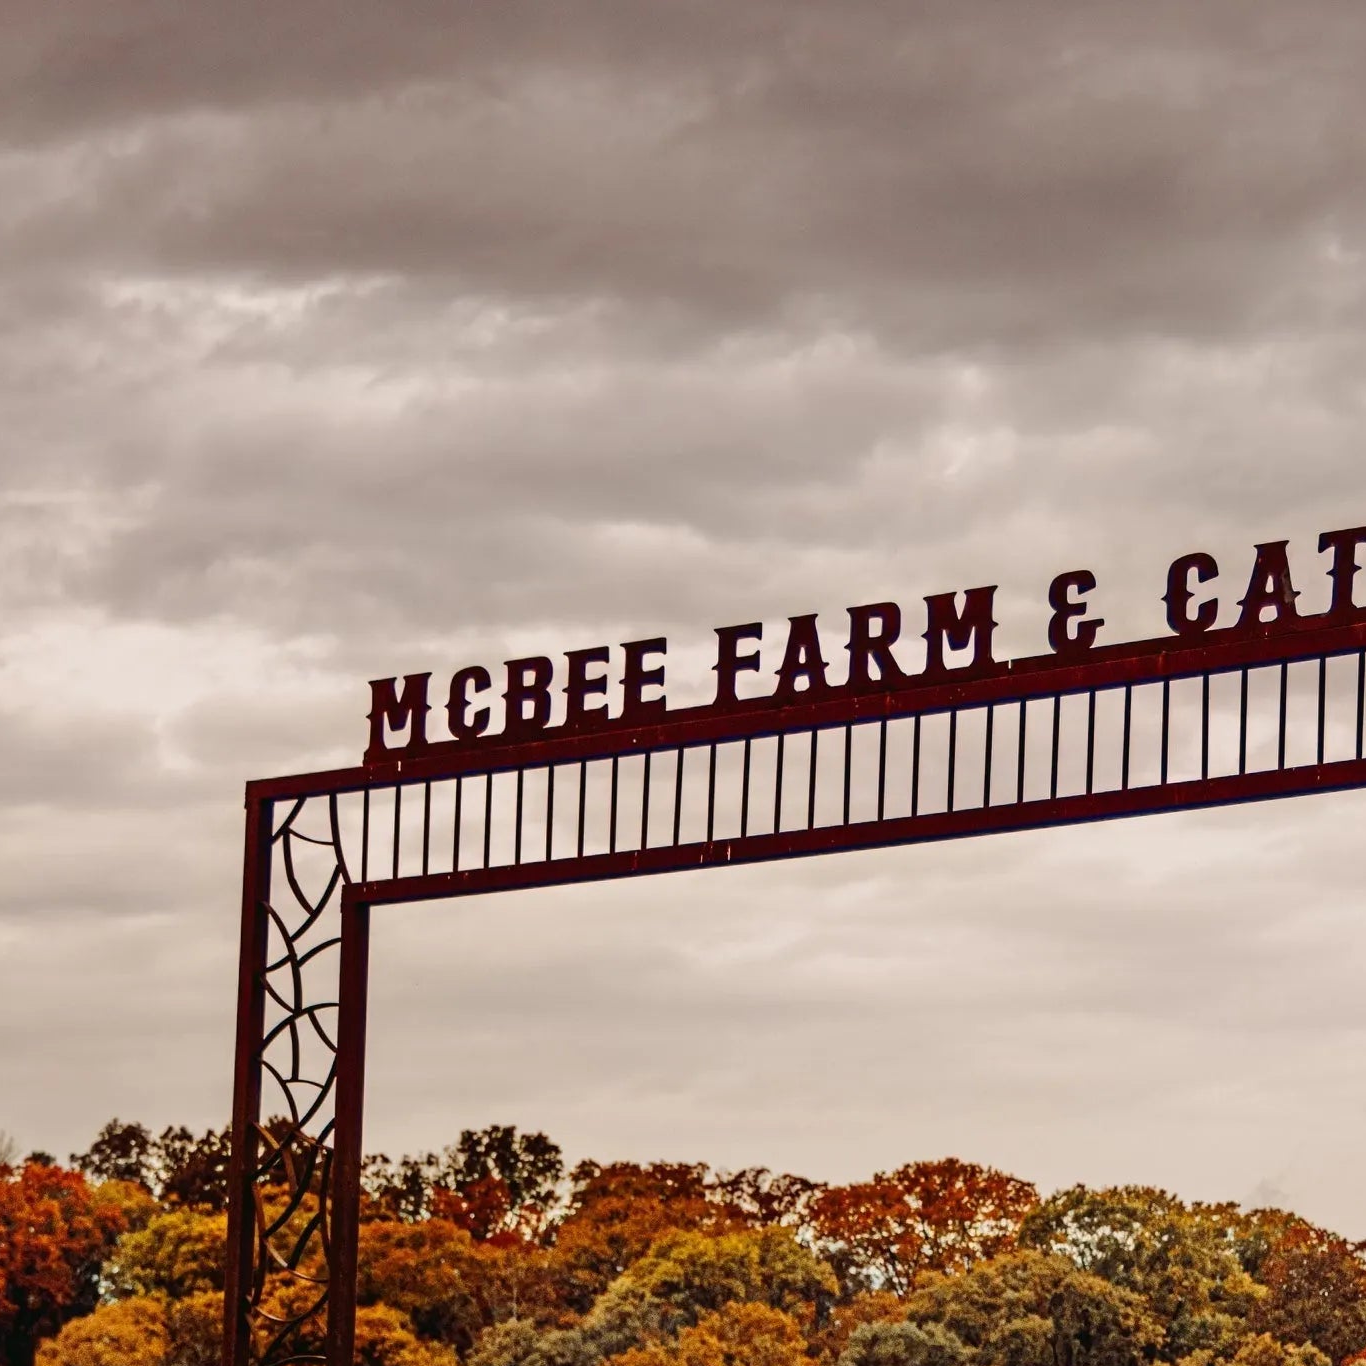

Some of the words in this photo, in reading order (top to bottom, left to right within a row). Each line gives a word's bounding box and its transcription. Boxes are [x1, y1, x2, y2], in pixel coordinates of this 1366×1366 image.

[365, 637, 667, 752] MCBEE
[712, 585, 998, 704] FARM
[1048, 569, 1105, 654] &
